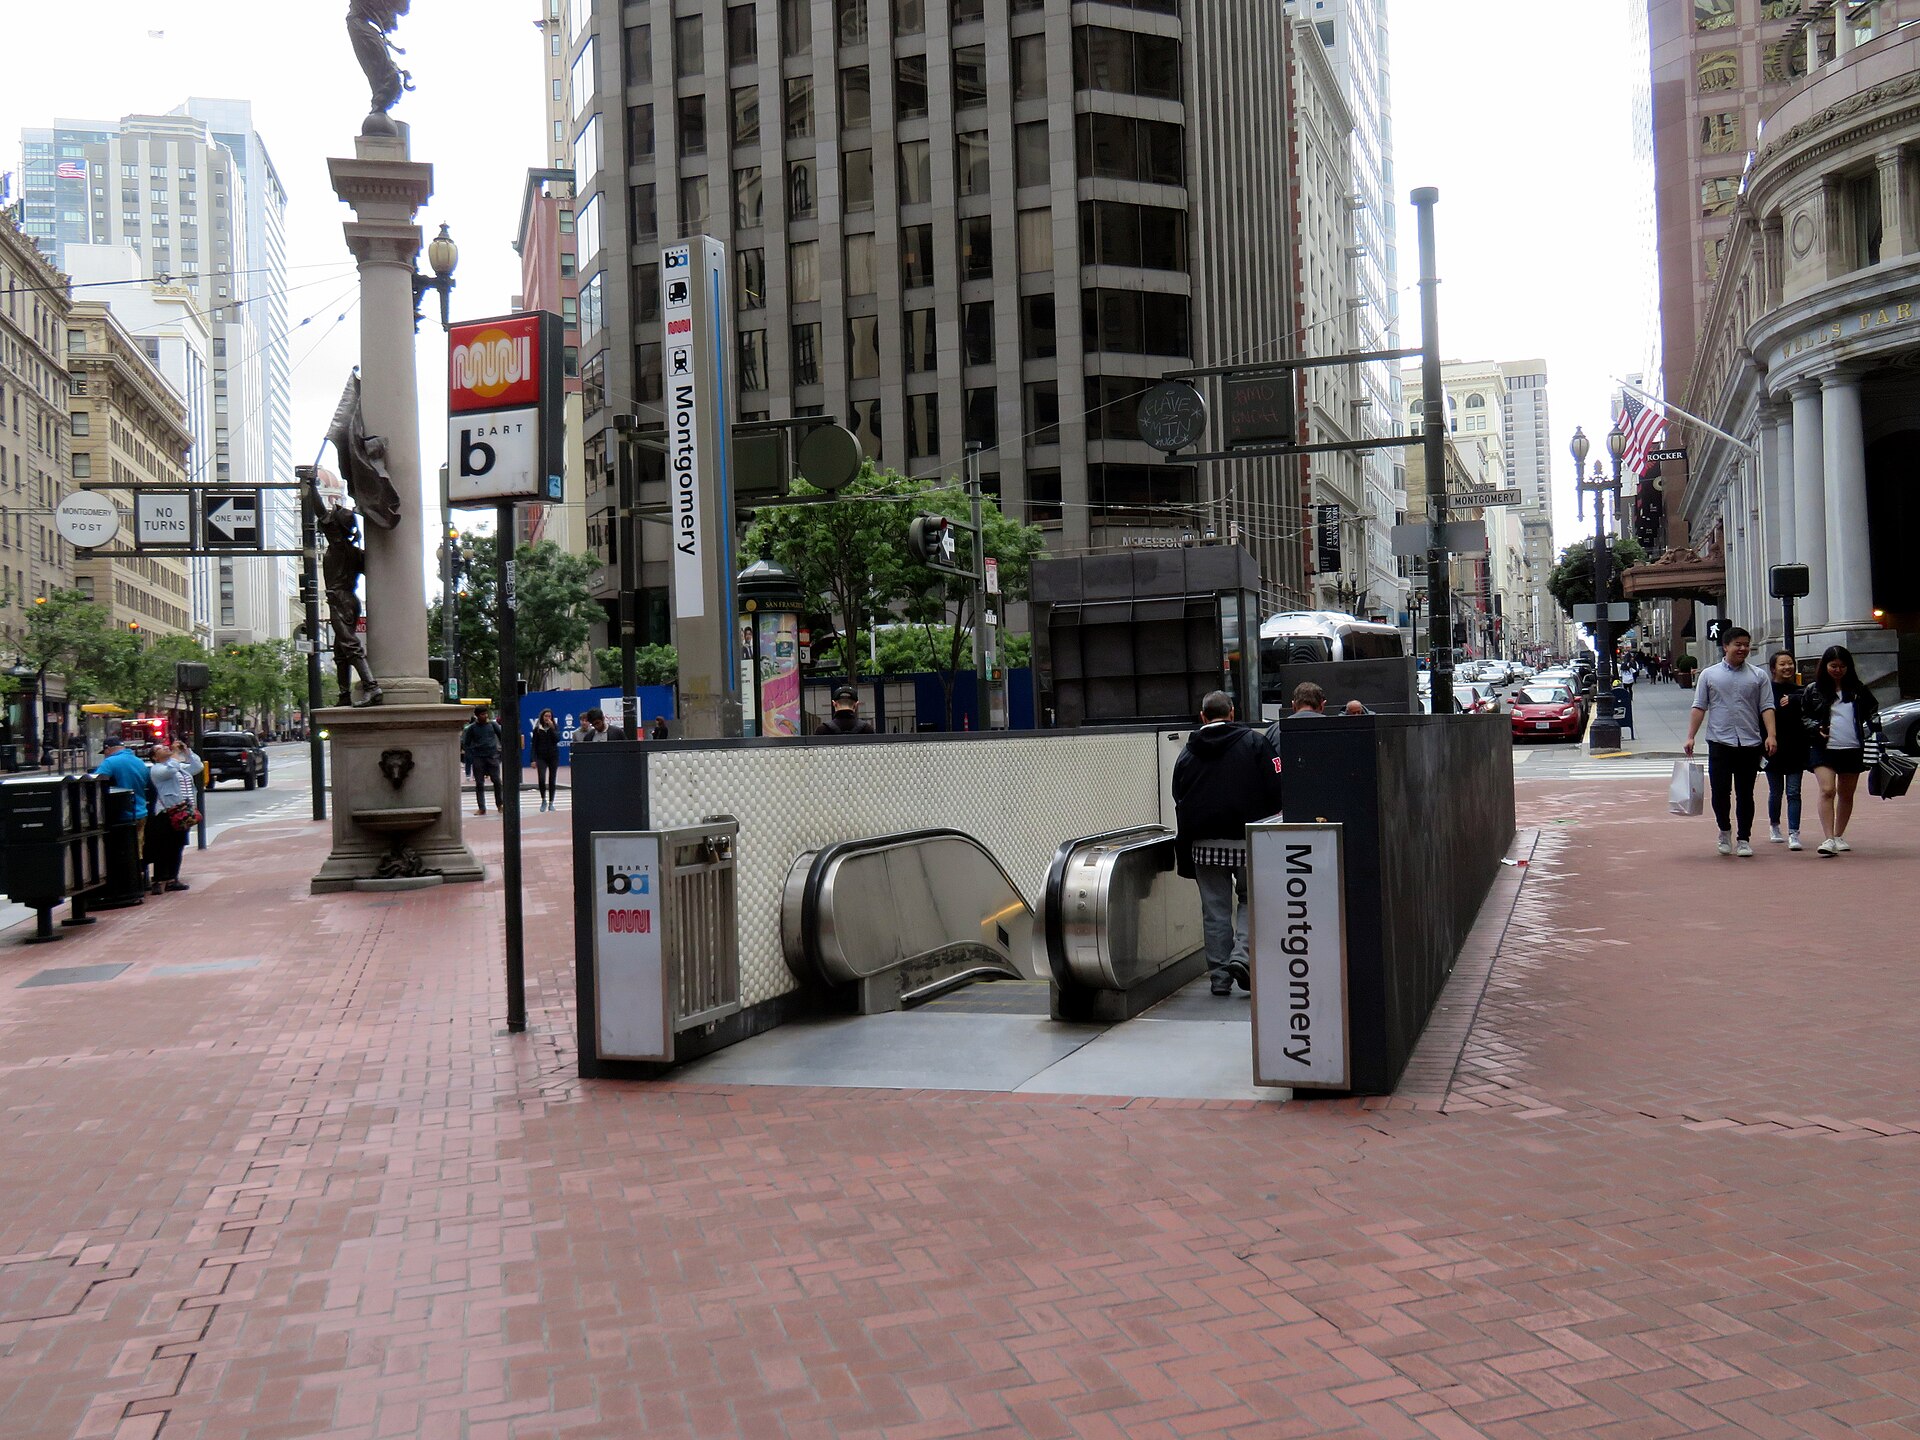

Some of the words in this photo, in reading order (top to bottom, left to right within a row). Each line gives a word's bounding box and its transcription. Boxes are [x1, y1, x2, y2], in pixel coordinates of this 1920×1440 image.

[1782, 323, 1842, 359] WELLS
[478, 424, 523, 437] BART
[461, 429, 496, 477] b
[674, 386, 695, 556] Montgomery
[1455, 493, 1514, 506] MONTGOMERY
[62, 507, 112, 517] MONTGOMERY
[156, 507, 173, 518] NO
[215, 514, 232, 523] ONE
[235, 514, 253, 522] WAY
[71, 523, 102, 531] POST
[144, 520, 186, 531] TURNS
[1281, 845, 1313, 1066] Montgomery
